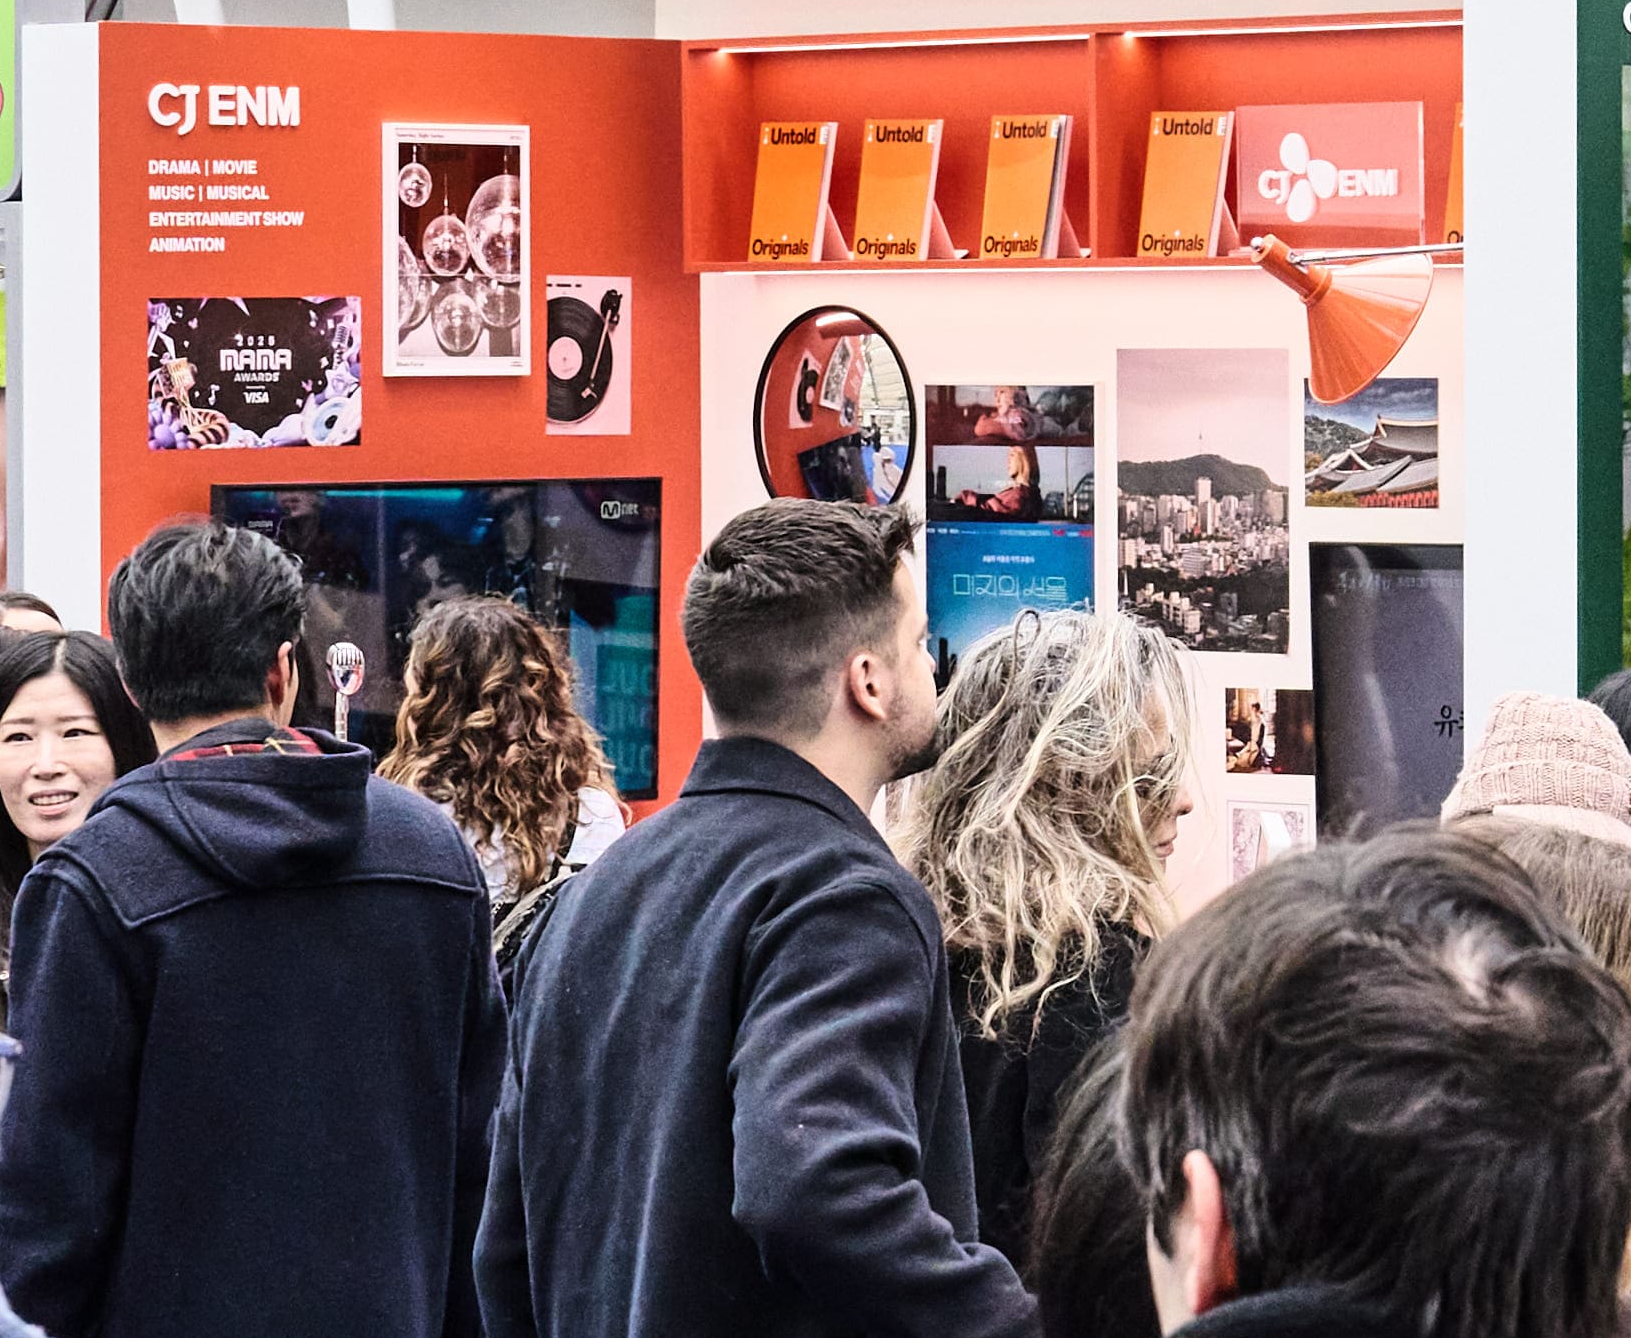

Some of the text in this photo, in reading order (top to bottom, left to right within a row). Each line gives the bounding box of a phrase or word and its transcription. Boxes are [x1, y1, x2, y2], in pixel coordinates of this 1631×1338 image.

[148, 83, 300, 135] CJ ENM
[771, 126, 817, 146] Untold
[875, 125, 924, 143] Untold
[1002, 119, 1047, 139] Untold
[1162, 118, 1214, 136] Untold
[148, 160, 257, 175] DRAMA MOVIE
[148, 185, 269, 200] MUSIC MUSICAL
[1258, 168, 1398, 205] CJ ENM
[148, 212, 304, 226] ENTERTAINMENT SHOW
[148, 237, 225, 252] ANIMATION
[752, 238, 809, 260] Originals
[856, 238, 916, 259] Originals
[984, 235, 1038, 257] Originals
[1141, 233, 1204, 256] Originals
[233, 372, 280, 382] AWARDS
[243, 391, 269, 404] VISA
